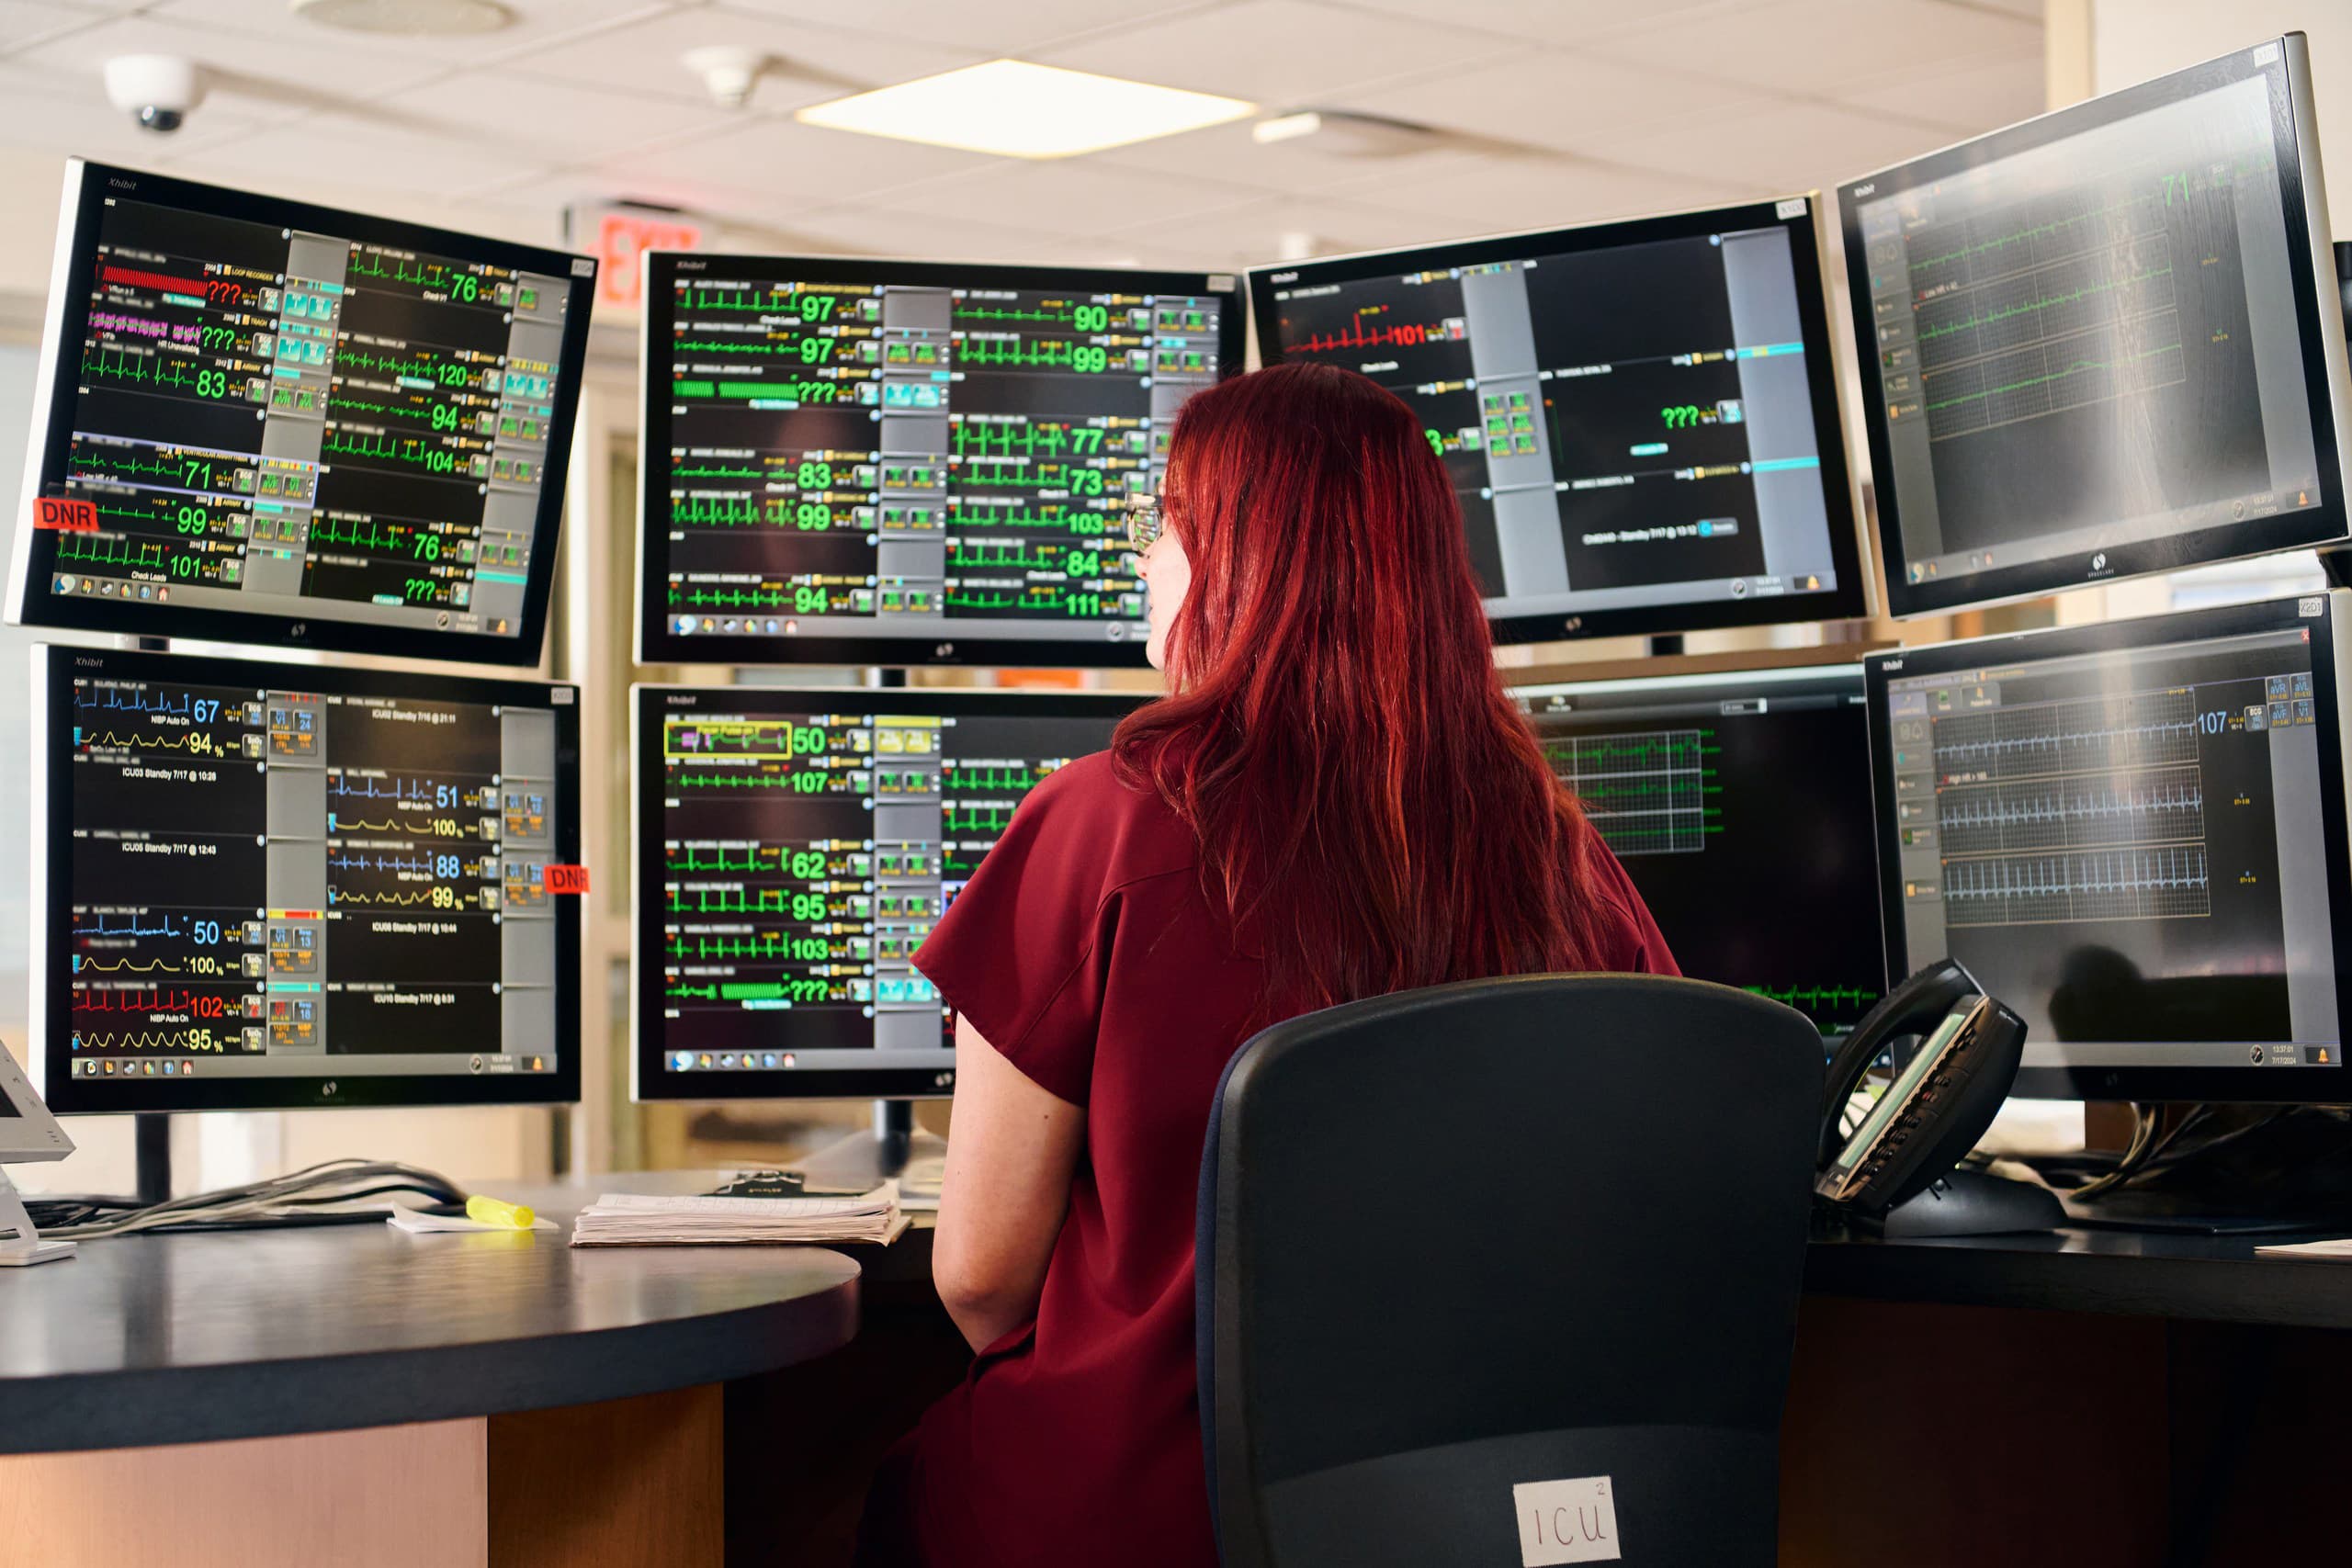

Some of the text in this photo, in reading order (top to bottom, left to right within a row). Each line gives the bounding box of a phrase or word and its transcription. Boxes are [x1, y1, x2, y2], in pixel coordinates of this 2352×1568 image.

[108, 177, 137, 190] Xhibit
[2162, 170, 2189, 207] 71
[209, 280, 242, 305] ???
[452, 274, 478, 302] 76
[802, 296, 835, 321] 97
[1074, 305, 1108, 333] 90
[202, 326, 235, 351] ???
[1393, 324, 1426, 346] 101
[800, 337, 835, 364] 97
[1072, 346, 1107, 373] 99
[196, 369, 226, 399] 83
[437, 364, 468, 387] 120
[797, 381, 836, 403] ???
[432, 404, 458, 431] 94
[1661, 405, 1699, 430] ???
[1070, 428, 1104, 455] 77
[425, 450, 454, 473] 104
[186, 460, 210, 490] 71
[797, 462, 831, 490] 83
[1069, 469, 1103, 496] 73
[41, 502, 91, 526] DNR
[177, 506, 207, 535] 99
[797, 504, 831, 531] 99
[1068, 513, 1104, 535] 103
[414, 533, 440, 561] 76
[131, 570, 149, 581] Check
[171, 555, 200, 579] 101
[1067, 551, 1101, 577] 84
[405, 579, 435, 602] ???
[795, 587, 828, 614] 94
[1065, 594, 1100, 616] 111
[2300, 602, 2322, 613] X2D1
[74, 657, 103, 668] Xhibit
[2270, 682, 2286, 694] aVR
[152, 715, 189, 726] NIBP Auto On
[193, 700, 220, 724] 67
[2250, 706, 2263, 716] ECG
[2198, 711, 2226, 735] 107
[189, 732, 212, 754] 94
[215, 745, 224, 758] %
[792, 728, 826, 754] 50
[145, 769, 172, 781] Standby
[174, 770, 187, 779] 7/17
[189, 772, 198, 783] @
[791, 772, 828, 794] 107
[436, 785, 458, 808] 51
[434, 819, 456, 837] 100
[145, 843, 172, 855] Standby
[173, 844, 187, 854] 7/17
[189, 846, 198, 856] @
[436, 855, 459, 879] 88
[792, 852, 826, 879] 62
[432, 886, 454, 908] 99
[792, 894, 826, 920] 95
[193, 920, 220, 945] 50
[791, 939, 829, 960] 103
[189, 957, 215, 974] 100
[216, 965, 224, 976] %
[789, 980, 829, 1002] ???
[150, 1014, 164, 1023] NIBP
[190, 996, 222, 1018] 102
[188, 1029, 211, 1051] 95
[214, 1040, 223, 1053] %
[2271, 1056, 2296, 1065] 7/17/2024
[1596, 1483, 1605, 1495] 2
[1535, 1505, 1607, 1545] ICU
